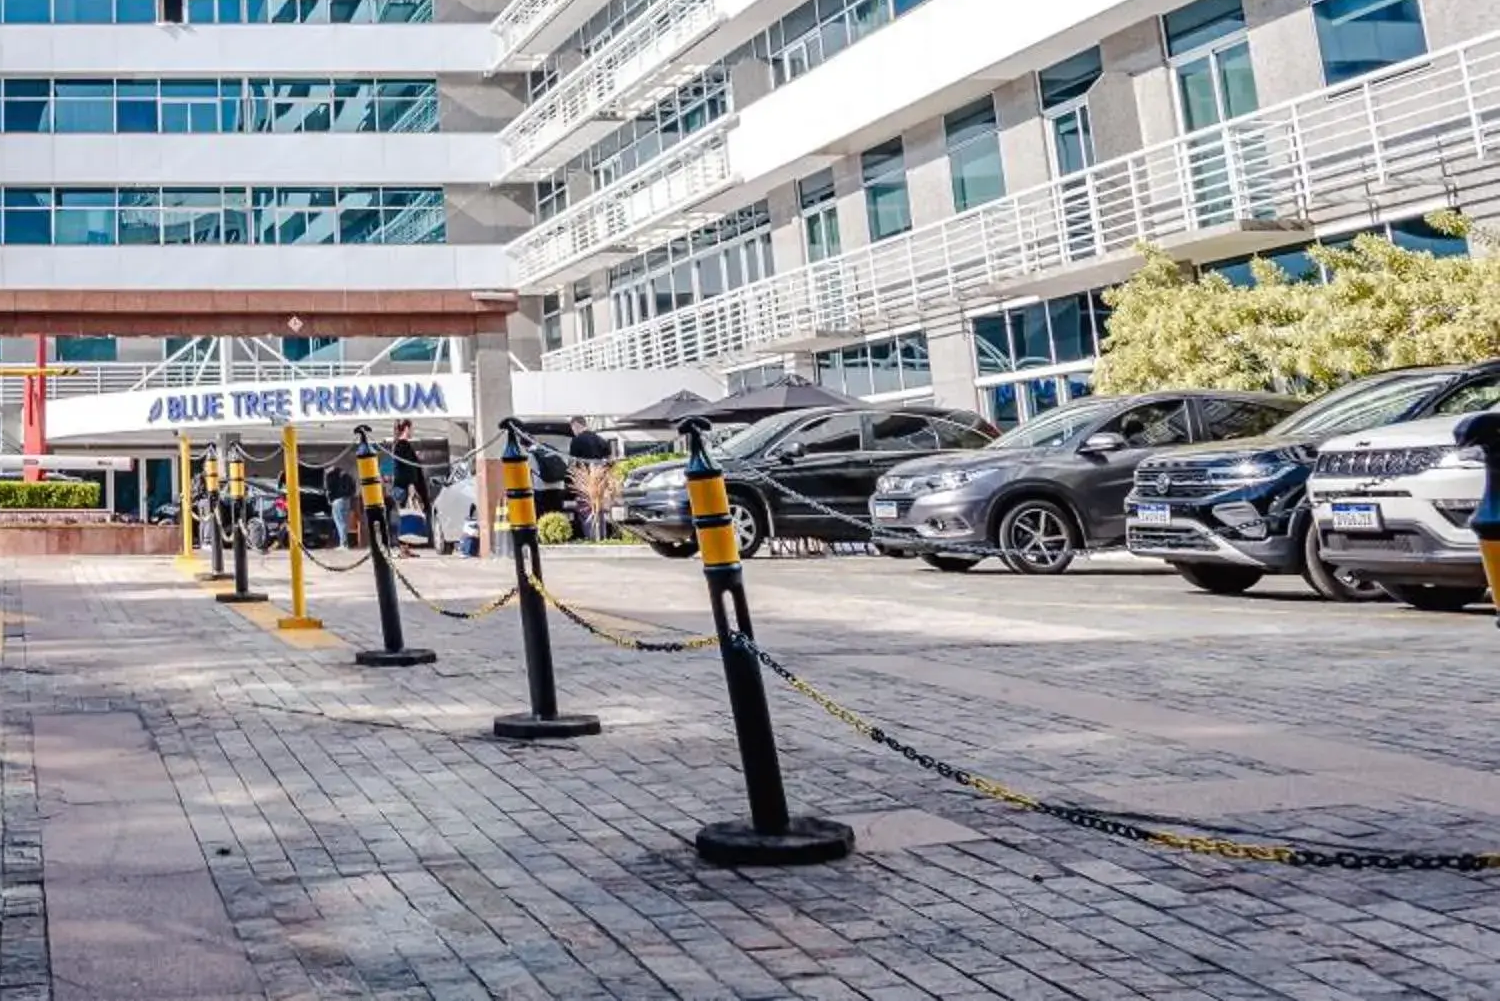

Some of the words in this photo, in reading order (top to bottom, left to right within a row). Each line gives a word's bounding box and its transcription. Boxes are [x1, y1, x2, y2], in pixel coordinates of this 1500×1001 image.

[166, 392, 225, 423] BLUE
[230, 388, 293, 419] TREE
[299, 381, 448, 417] PREMIUM
